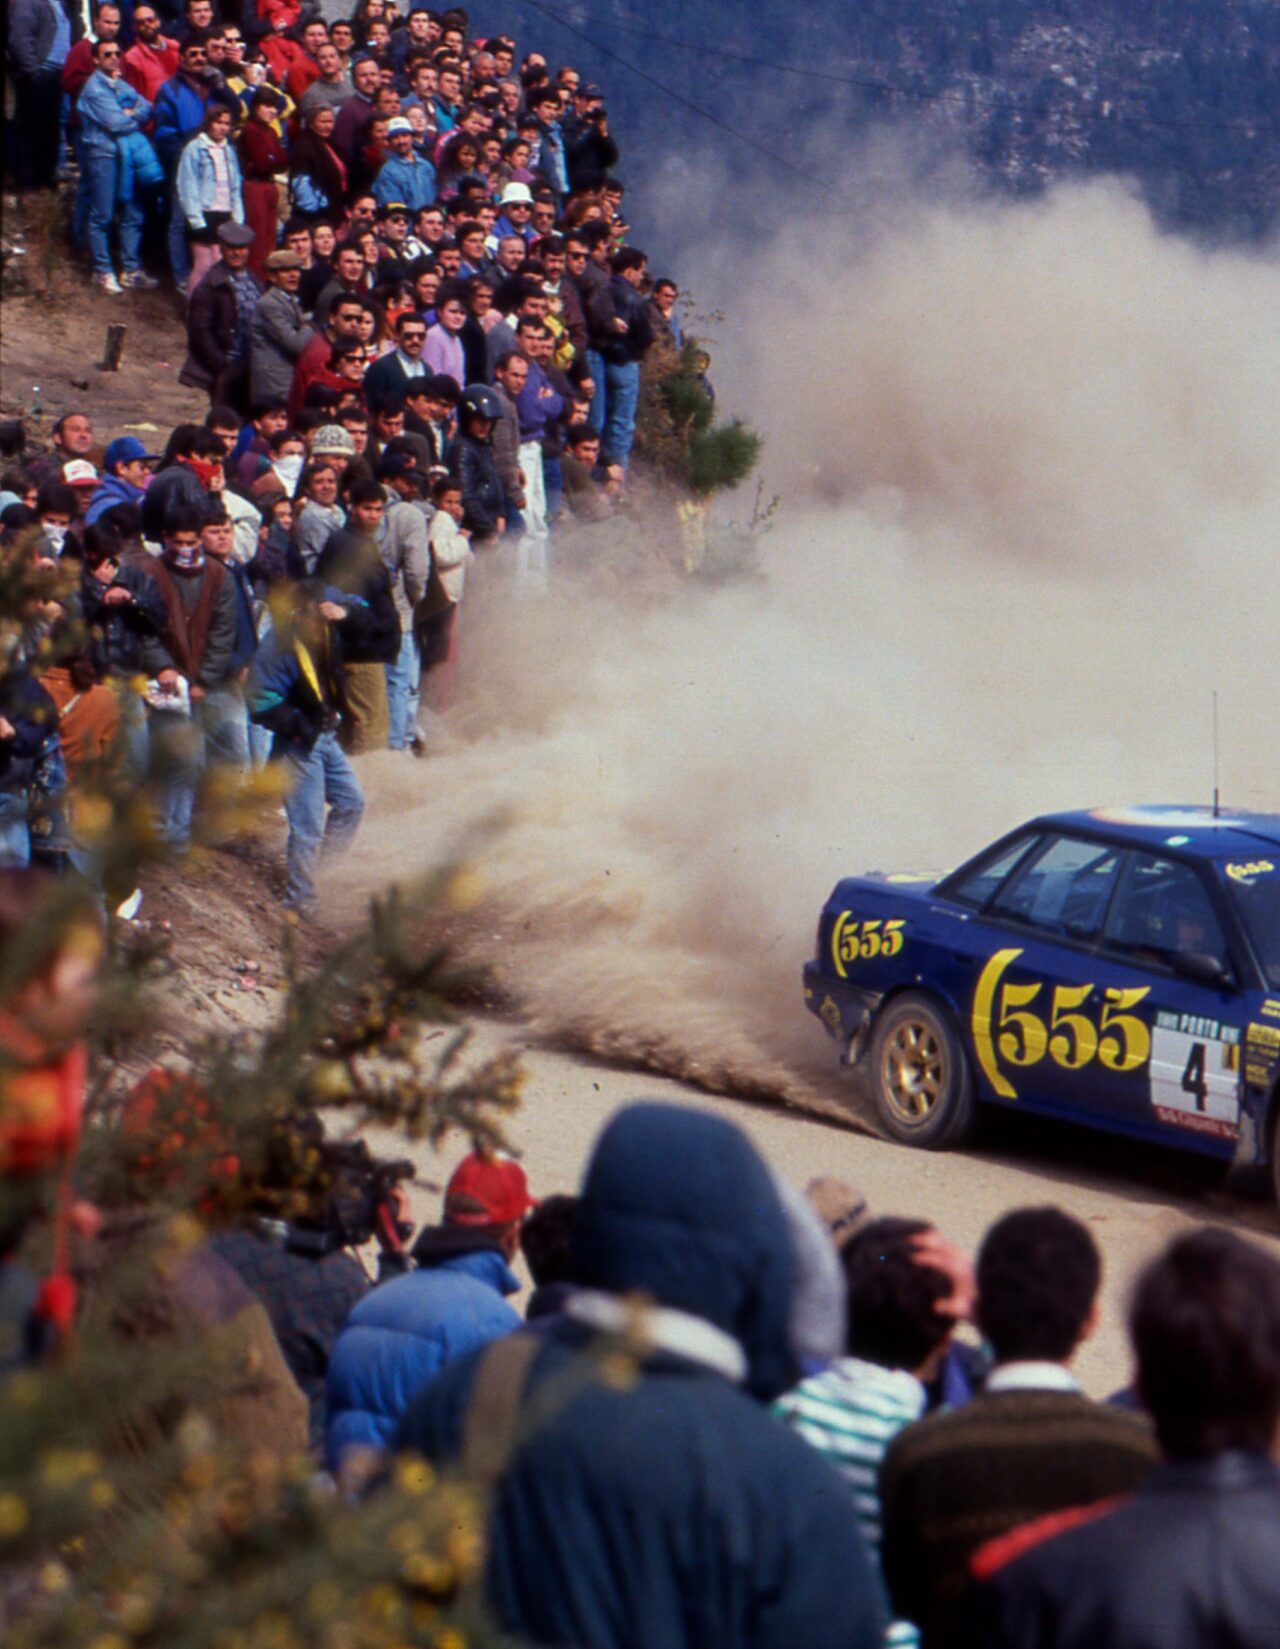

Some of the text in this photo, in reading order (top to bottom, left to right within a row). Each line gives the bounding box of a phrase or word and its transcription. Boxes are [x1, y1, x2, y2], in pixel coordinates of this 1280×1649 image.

[841, 919, 907, 962] 555
[998, 982, 1152, 1072] 555
[1181, 1042, 1208, 1112] 4
